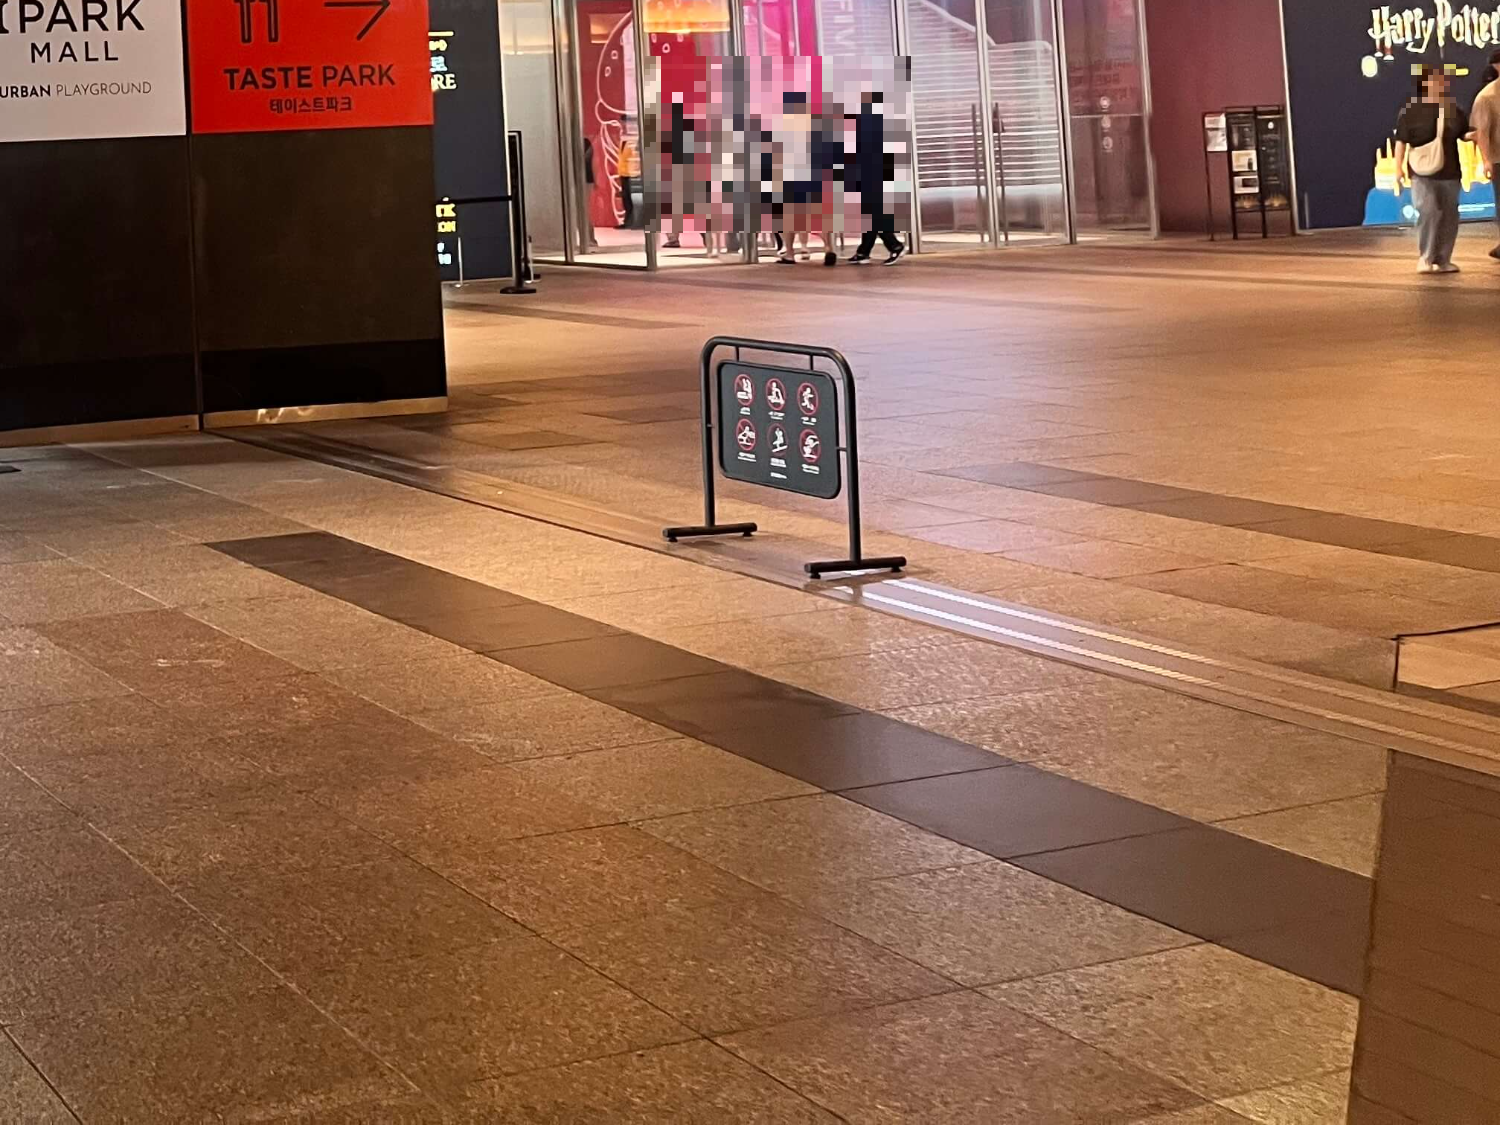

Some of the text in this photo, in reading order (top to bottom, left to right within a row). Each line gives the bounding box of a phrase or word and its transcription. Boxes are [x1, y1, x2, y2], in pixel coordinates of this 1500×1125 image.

[1368, 5, 1435, 61] Harry
[30, 40, 119, 64] MALL
[56, 81, 153, 97] PLAYGROUND
[223, 63, 396, 91] TASTE PARK
[269, 96, 353, 114] 테이스트파크
